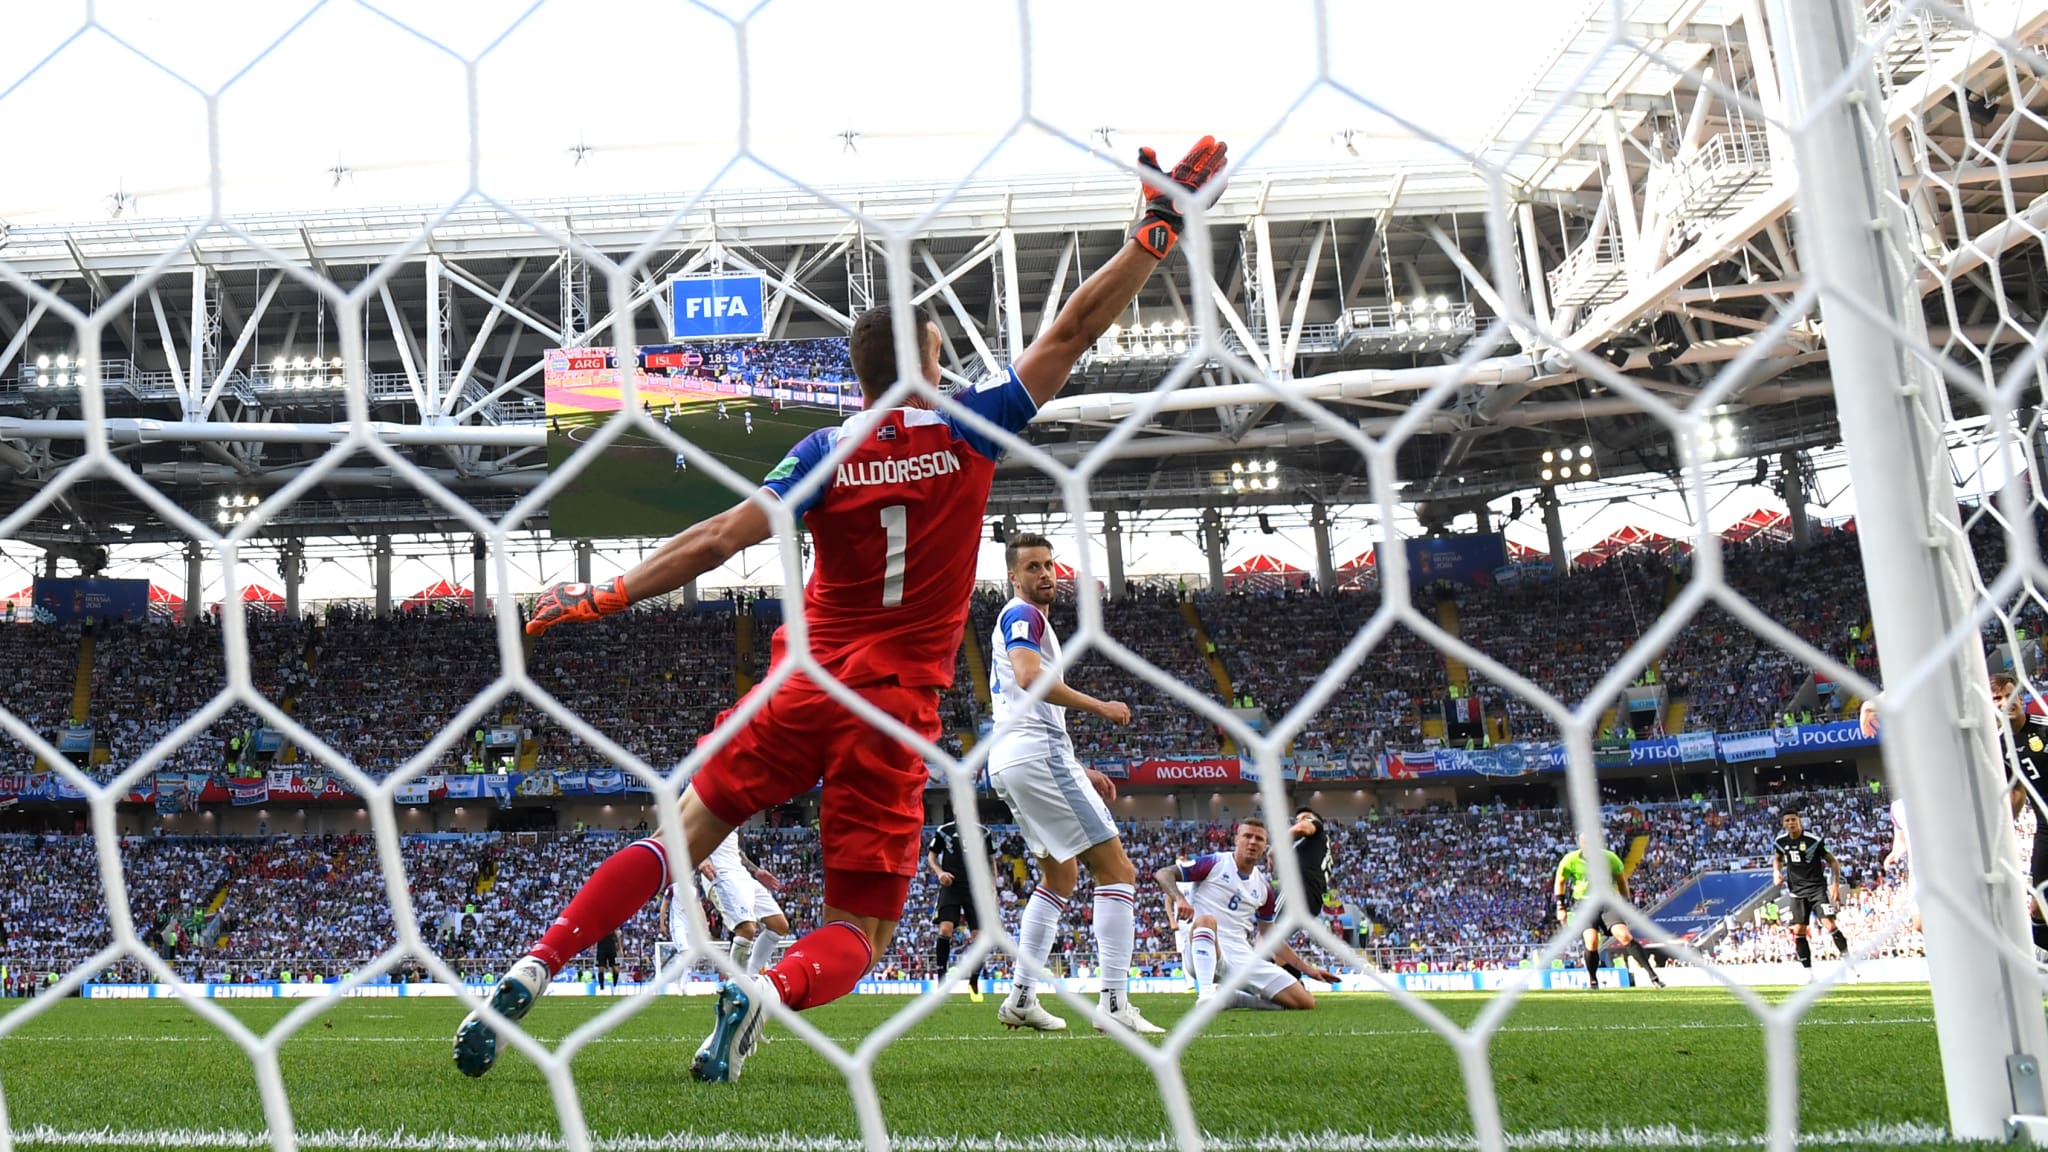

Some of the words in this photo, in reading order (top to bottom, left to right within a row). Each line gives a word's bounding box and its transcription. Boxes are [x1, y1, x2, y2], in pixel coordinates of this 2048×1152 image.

[686, 295, 749, 319] FIFA
[574, 358, 600, 369] ARG
[655, 353, 673, 365] ISL
[708, 352, 739, 364] 18:36
[832, 450, 960, 489] ALLDÓRSSON
[880, 504, 906, 608] 1
[1156, 766, 1228, 779] МОСКВА
[1789, 850, 1801, 863] 16
[1227, 895, 1242, 911] 6
